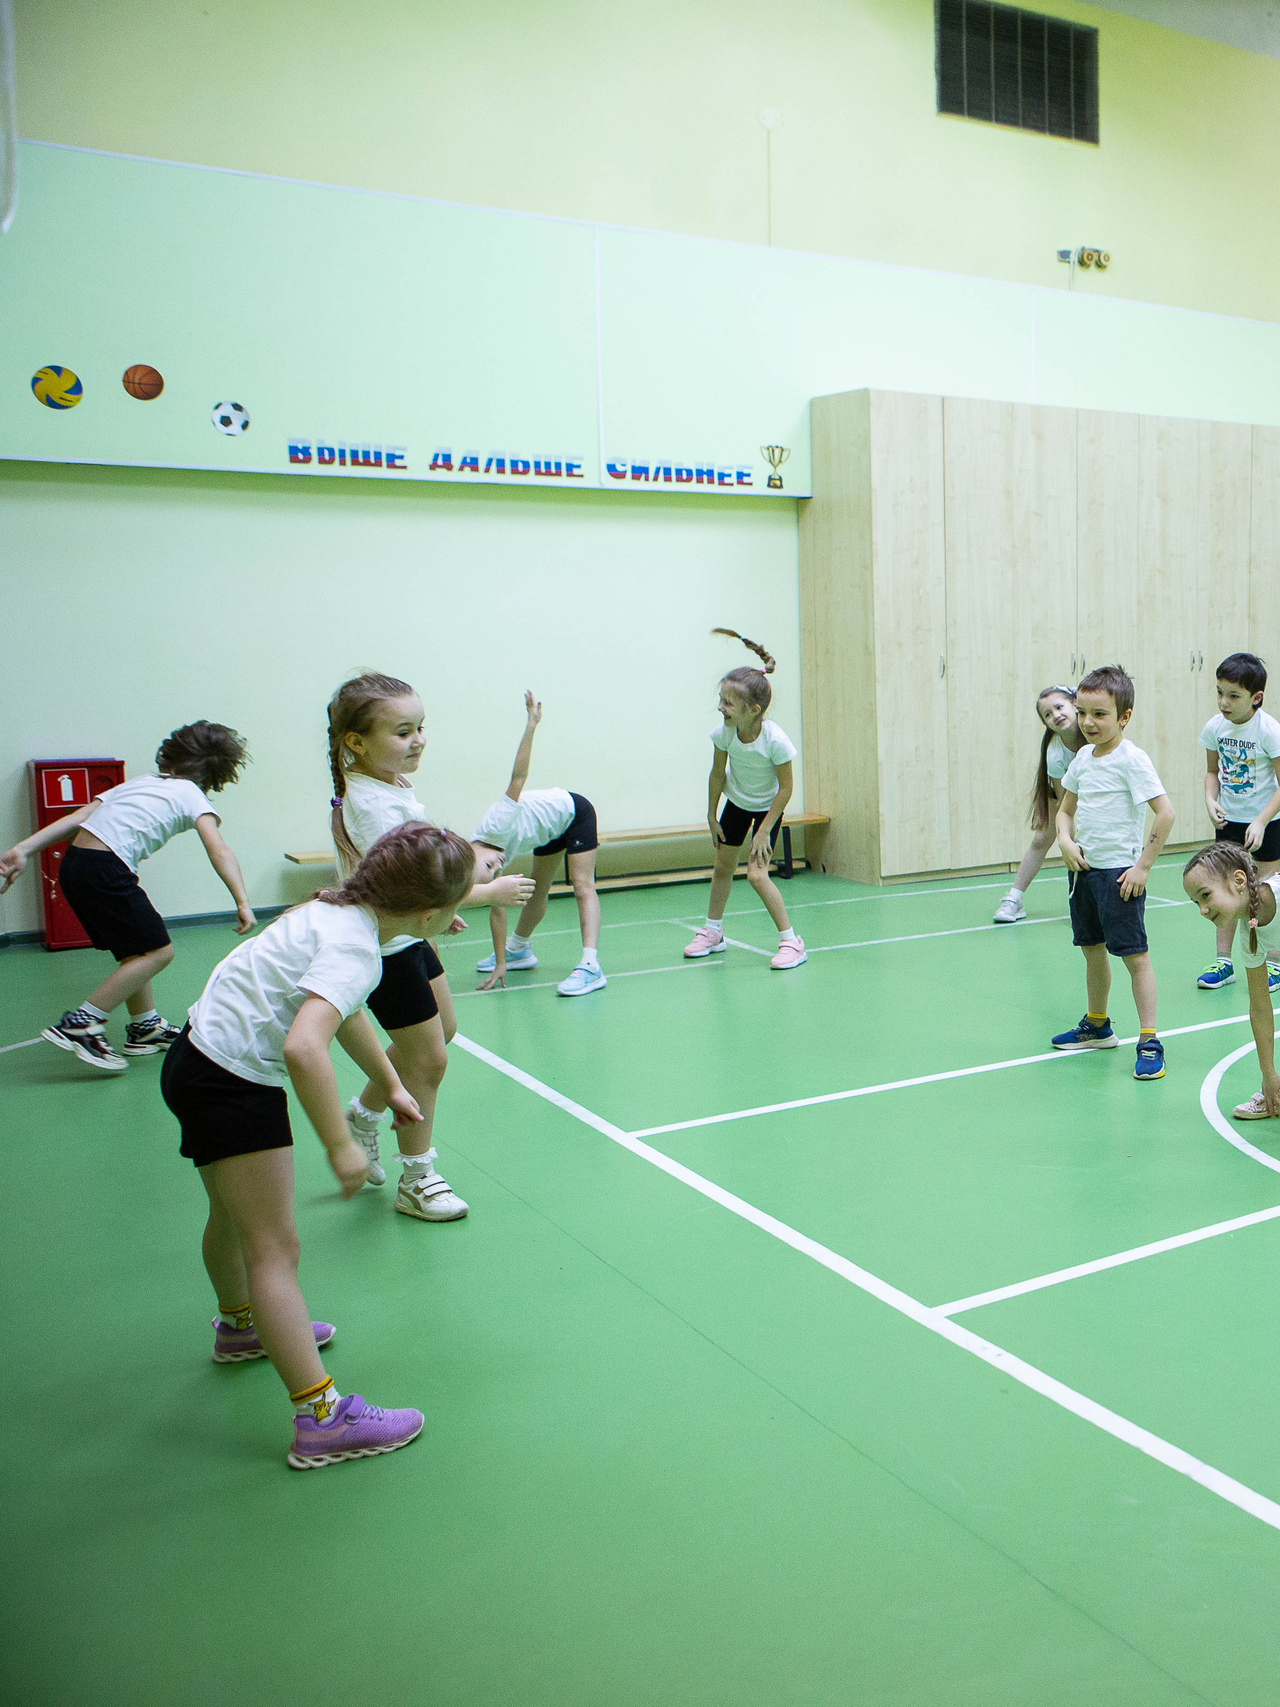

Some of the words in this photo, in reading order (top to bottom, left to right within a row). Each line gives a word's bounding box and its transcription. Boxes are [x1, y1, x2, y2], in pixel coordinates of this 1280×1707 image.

[288, 437, 408, 470] ВЫШЕ
[429, 446, 584, 478] ДАЛЬШЕ
[605, 456, 754, 487] СИЛЬНЕЕ
[1217, 737, 1238, 747] SKATER
[1239, 740, 1256, 749] DUDE
